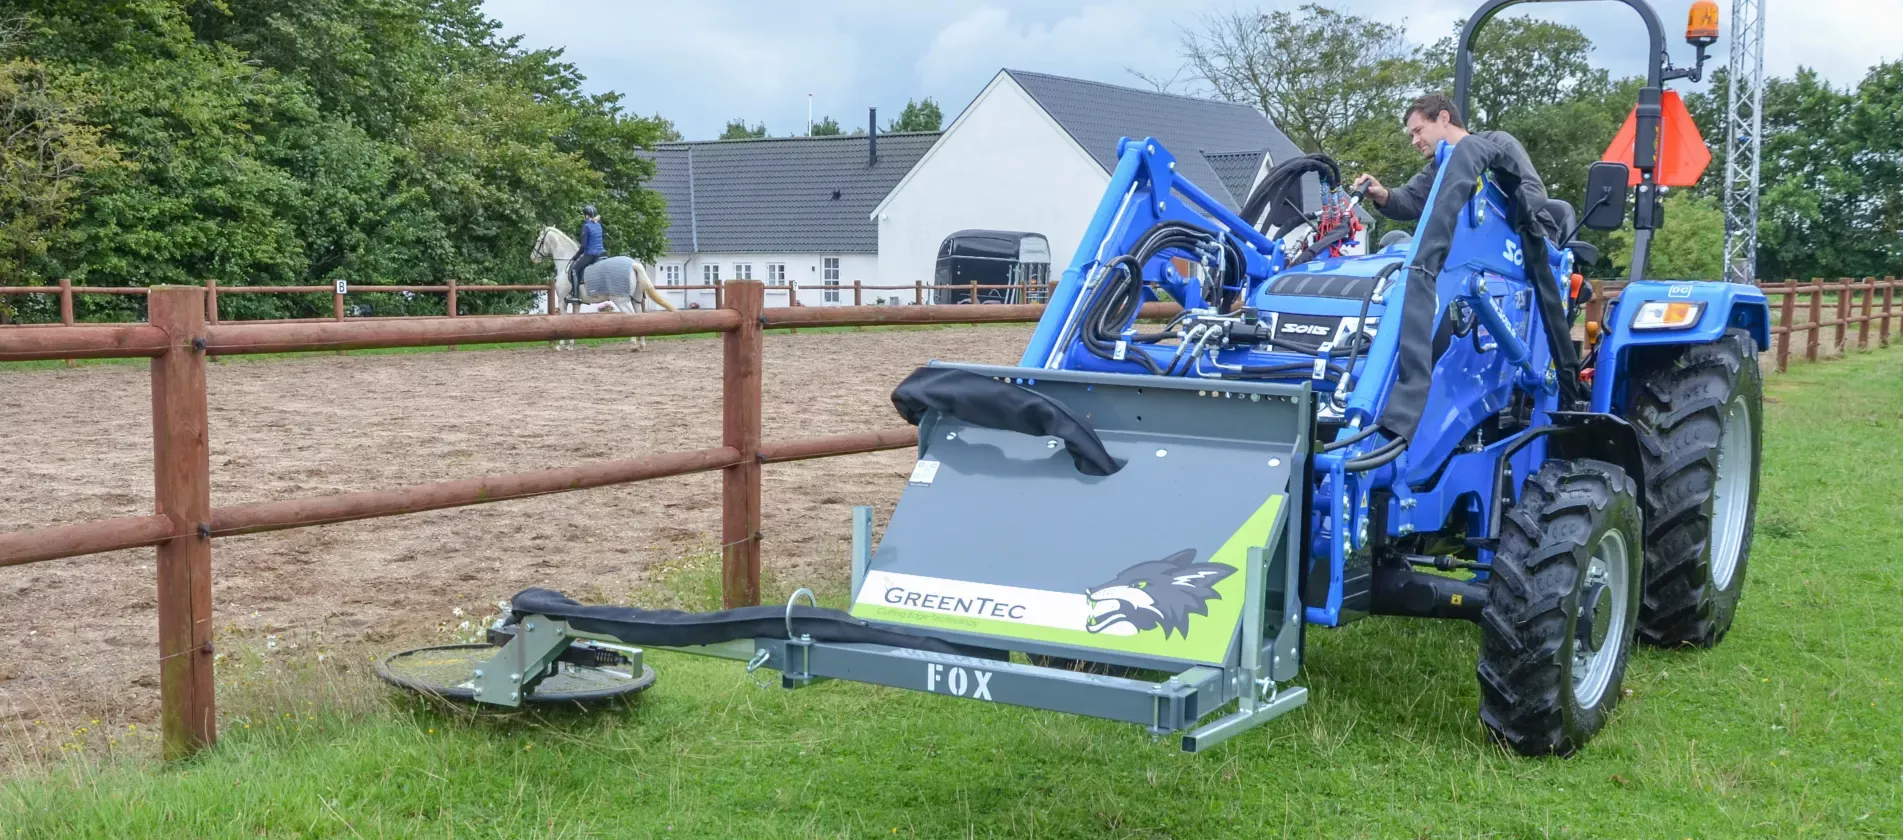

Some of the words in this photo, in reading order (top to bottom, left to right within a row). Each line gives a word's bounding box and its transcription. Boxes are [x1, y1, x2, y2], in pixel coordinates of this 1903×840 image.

[338, 281, 345, 292] B
[1672, 286, 1689, 294] DC
[927, 662, 993, 701] FOX
